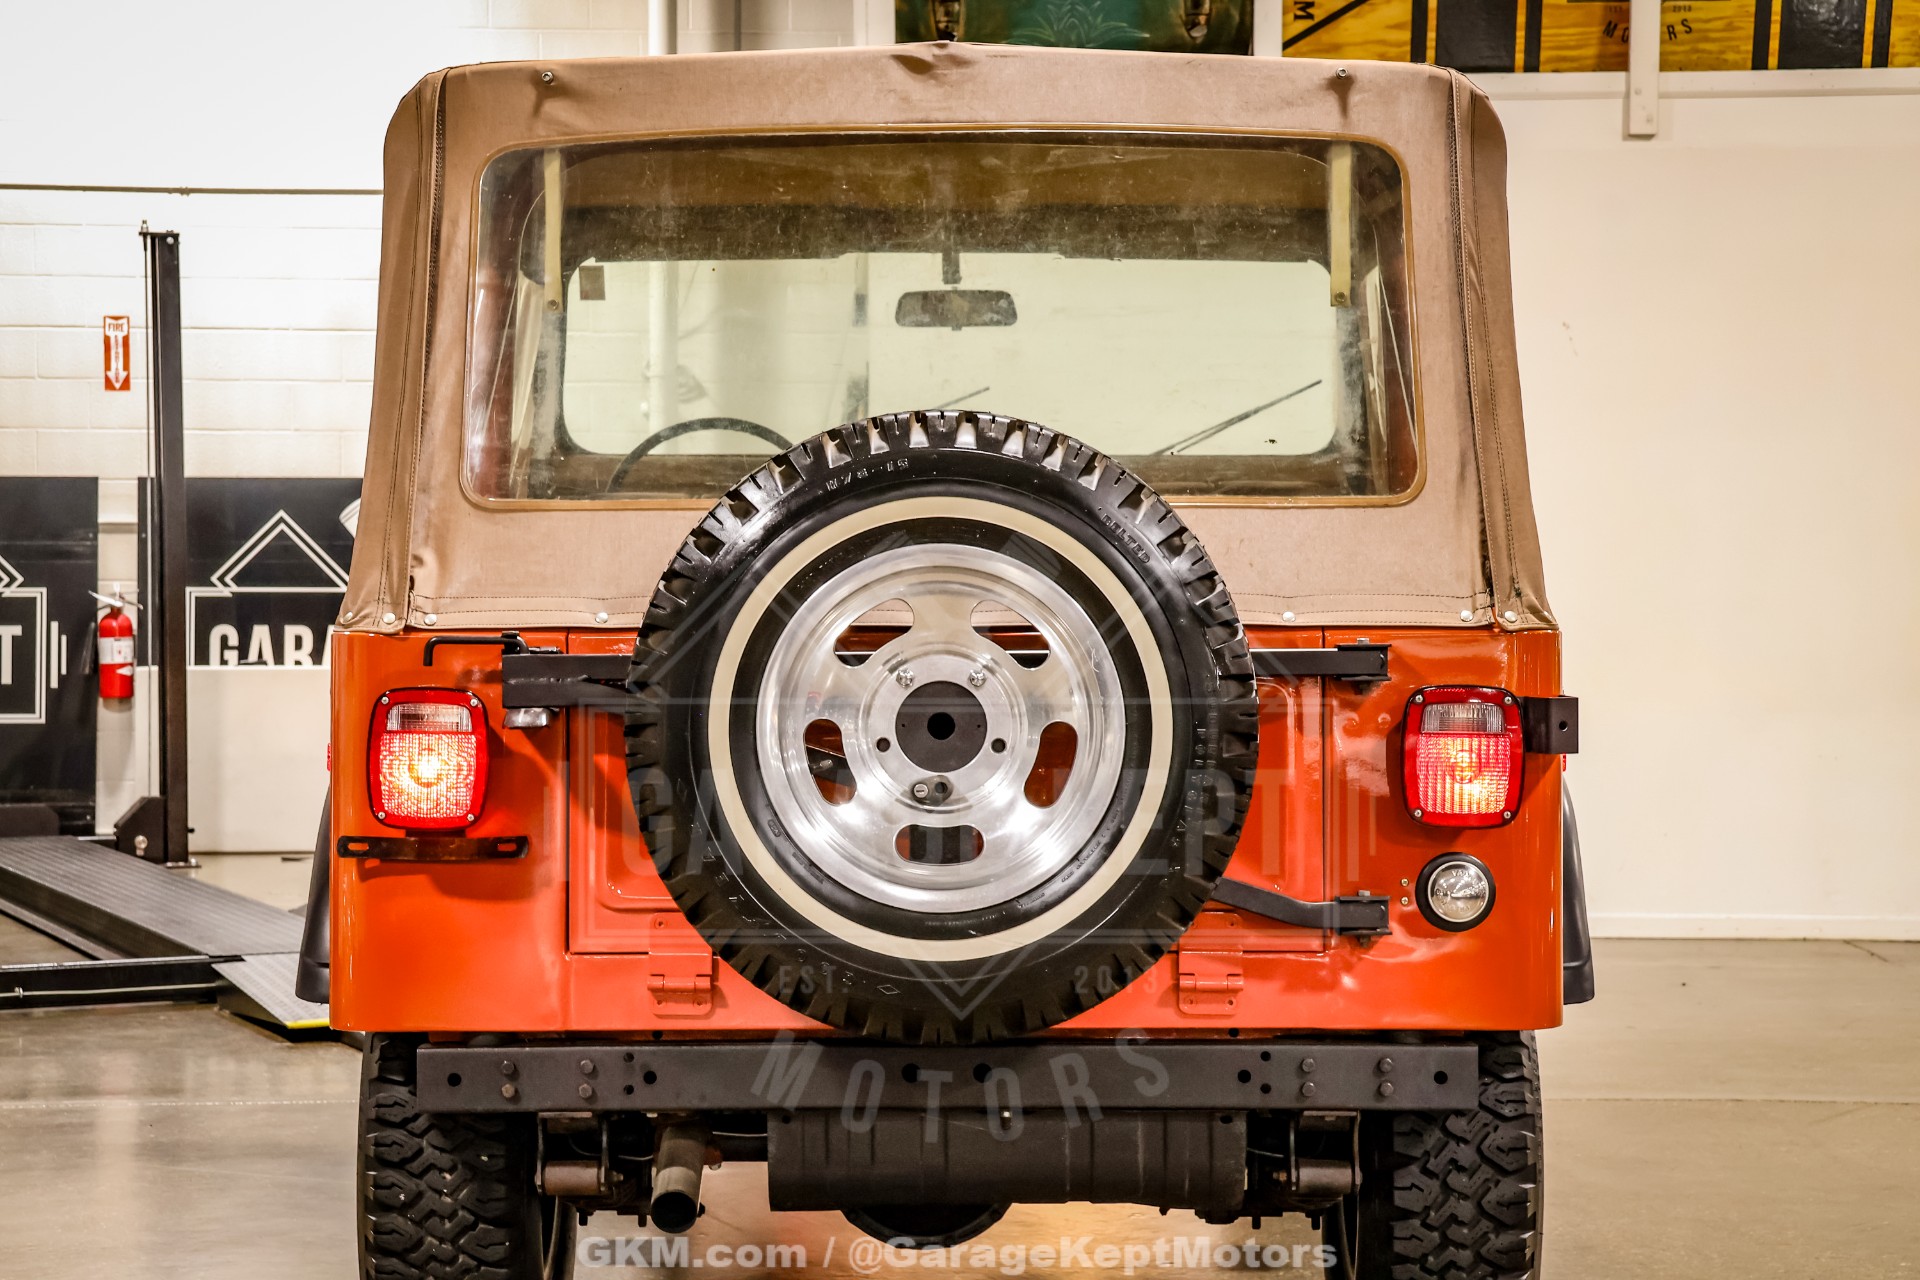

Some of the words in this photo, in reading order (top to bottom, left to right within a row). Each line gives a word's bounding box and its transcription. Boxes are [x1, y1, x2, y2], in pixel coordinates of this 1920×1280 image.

[1603, 18, 1693, 43] MORS
[107, 322, 125, 333] FIRE
[1100, 513, 1151, 564] BELTED
